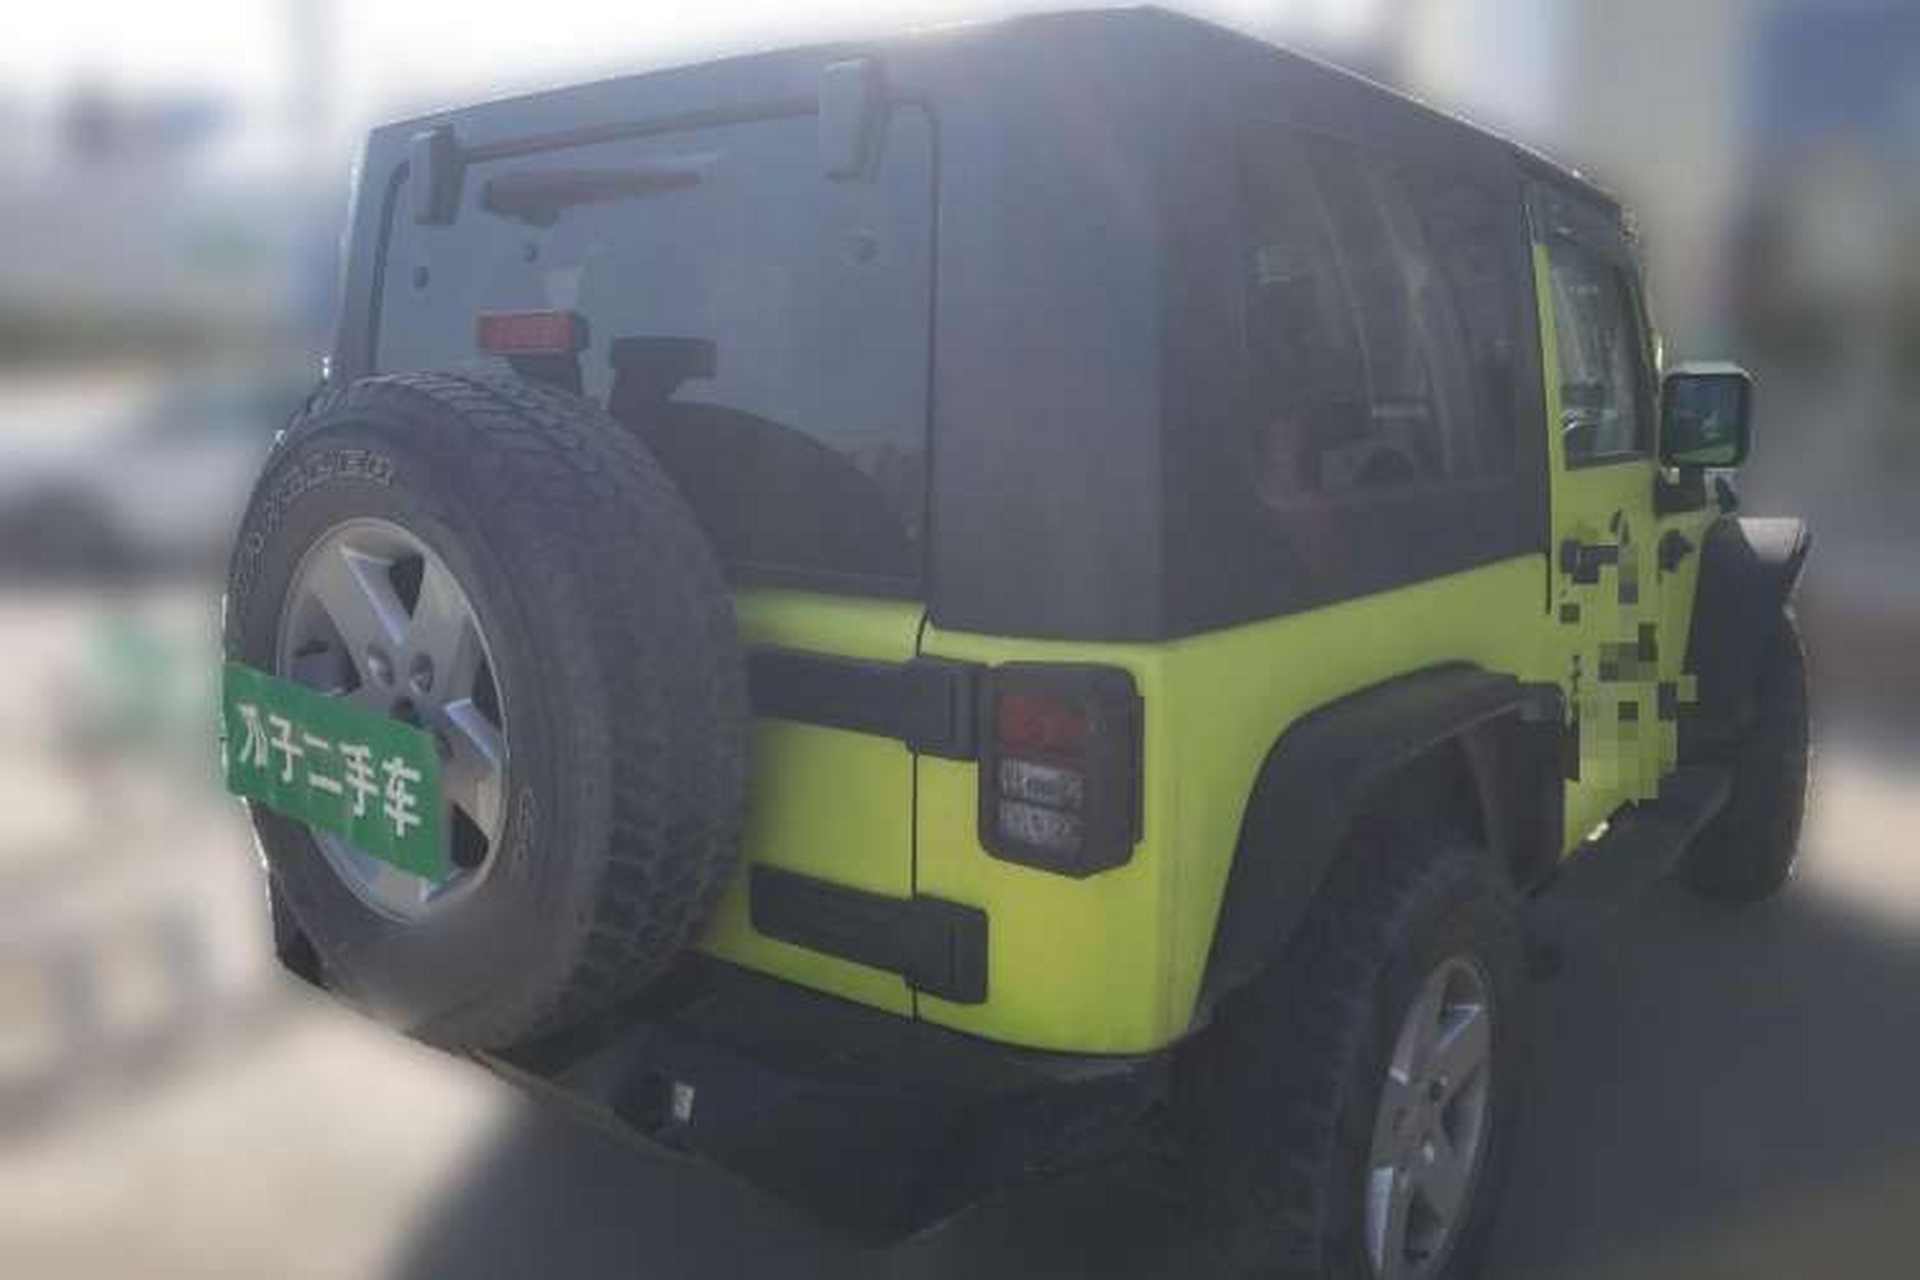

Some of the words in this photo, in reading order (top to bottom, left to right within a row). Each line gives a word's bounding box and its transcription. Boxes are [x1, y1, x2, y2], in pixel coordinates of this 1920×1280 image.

[236, 702, 423, 838] 瓜子二手车
